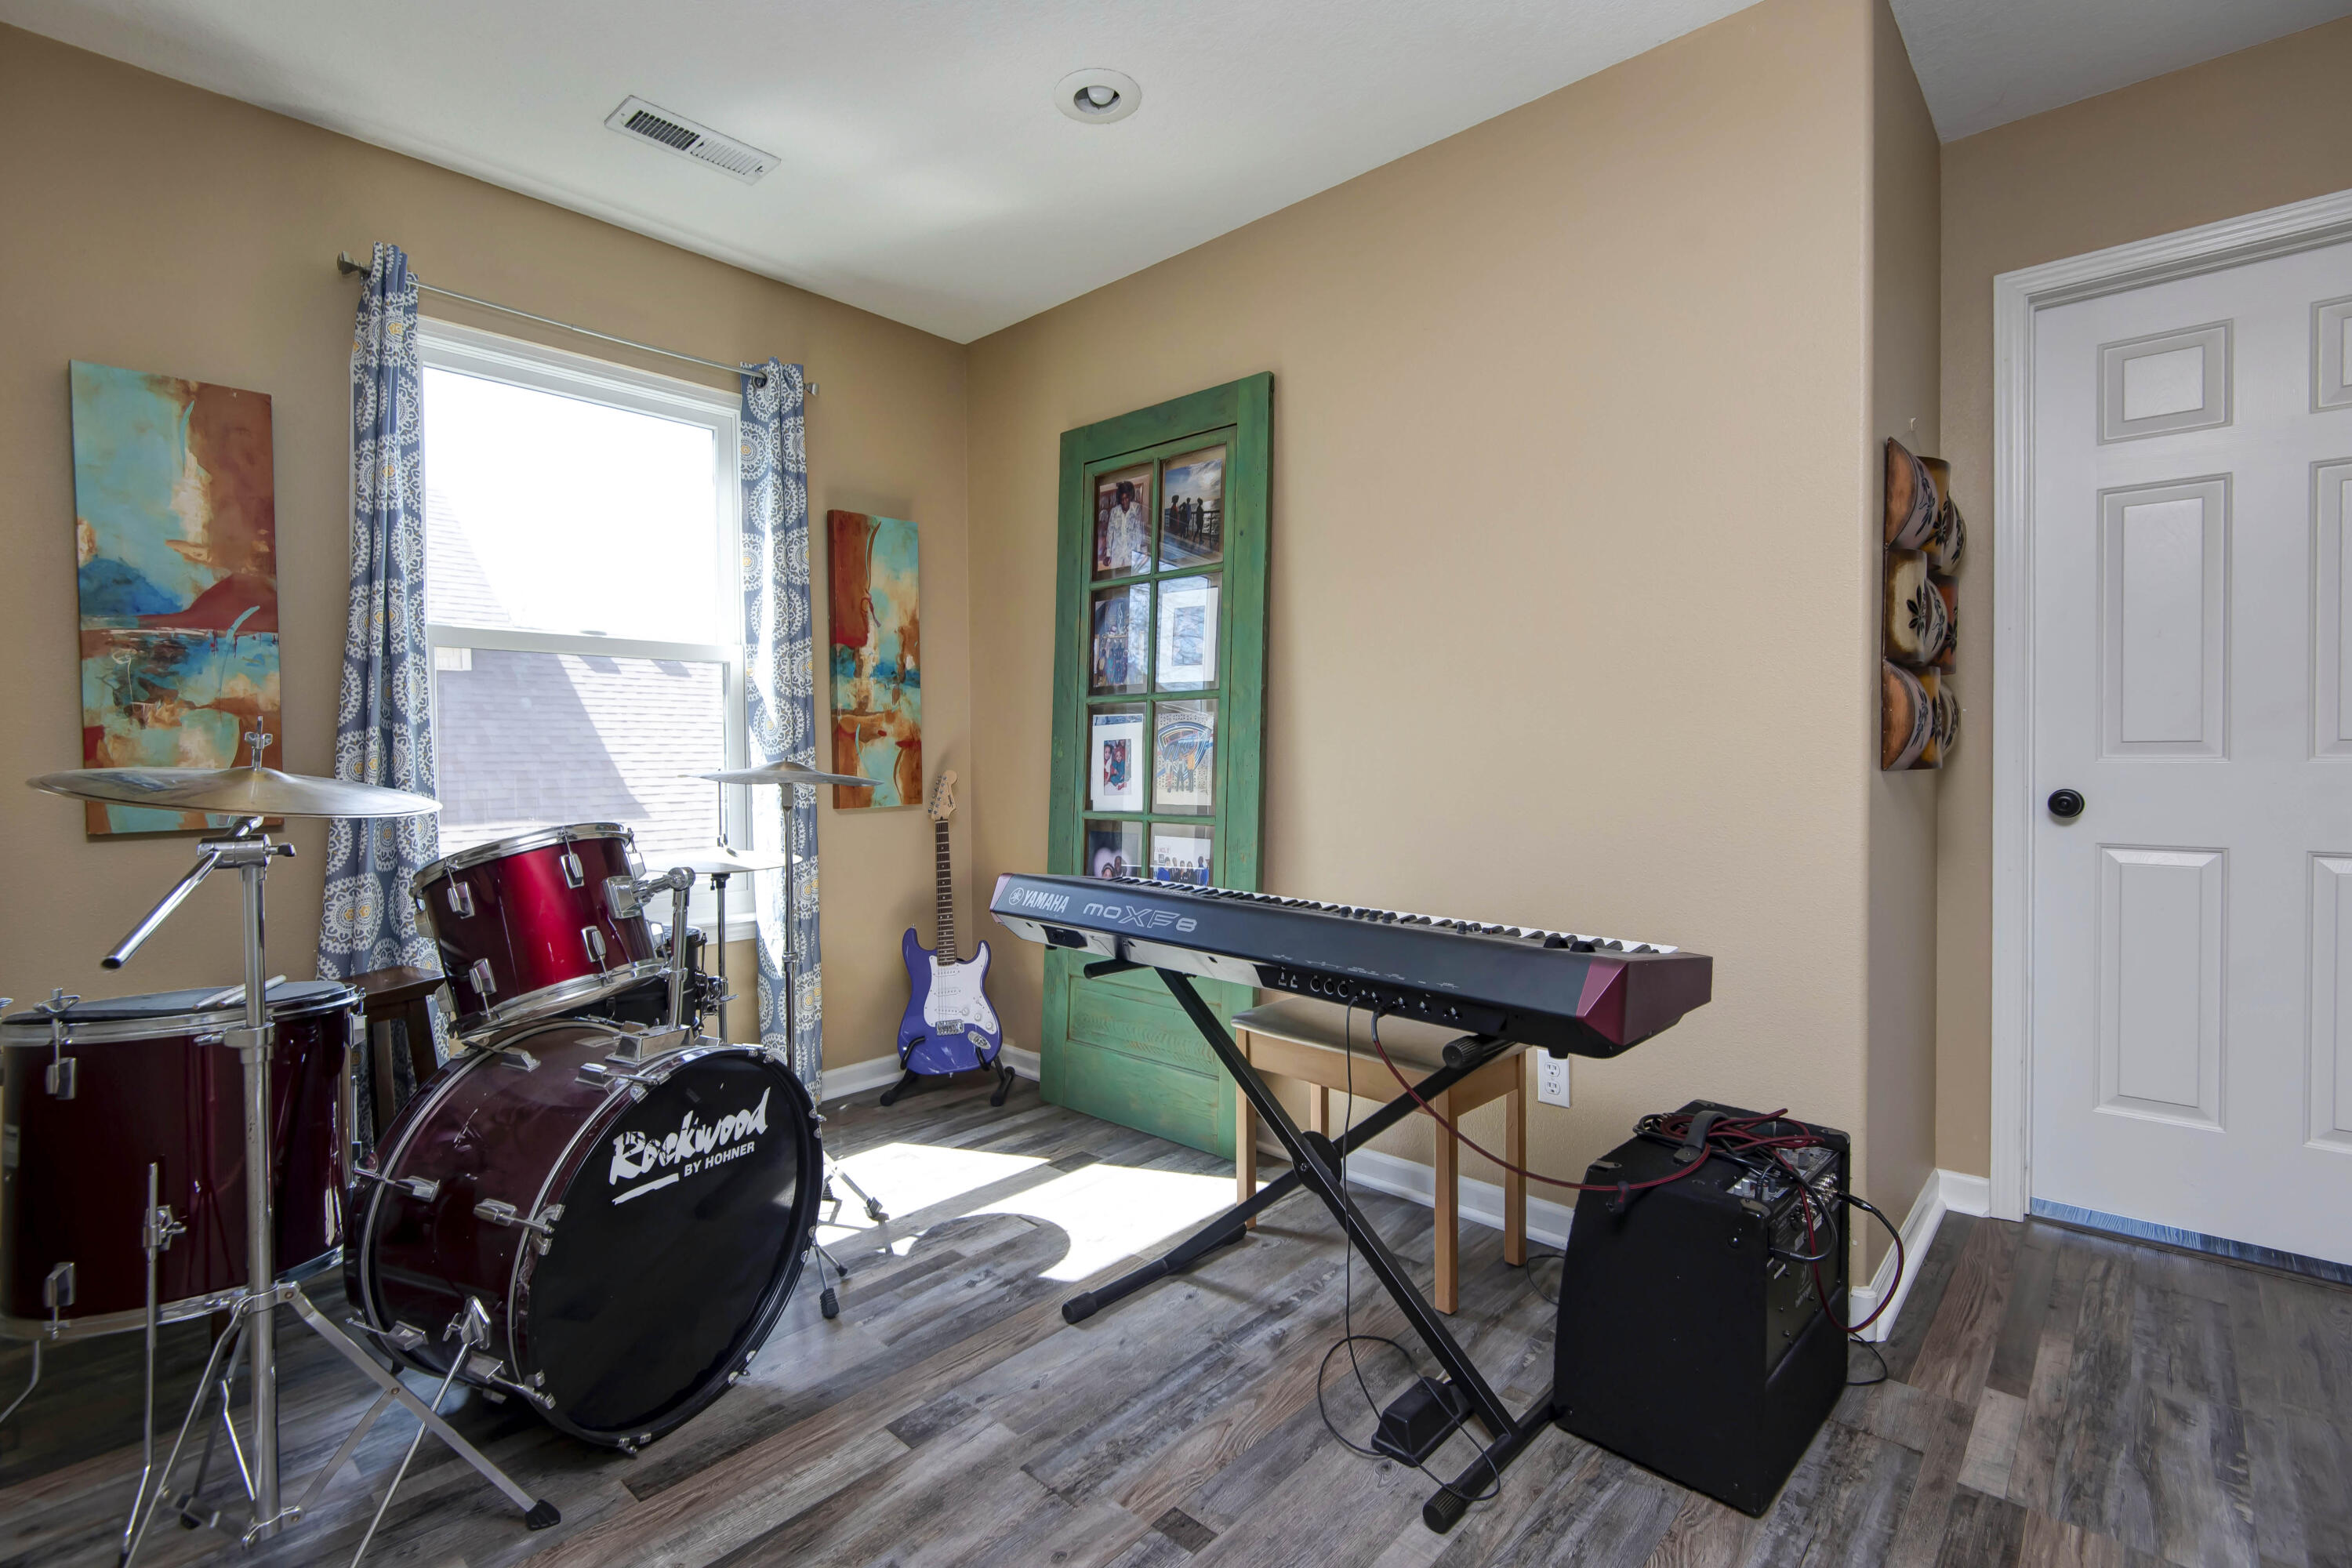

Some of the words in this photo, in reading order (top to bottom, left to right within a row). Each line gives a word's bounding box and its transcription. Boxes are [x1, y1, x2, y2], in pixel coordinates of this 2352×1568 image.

[1022, 890, 1070, 913] YAMAHA
[609, 1087, 771, 1185] Rockwood
[684, 1160, 702, 1177] BY
[705, 1142, 755, 1169] HOHNER
